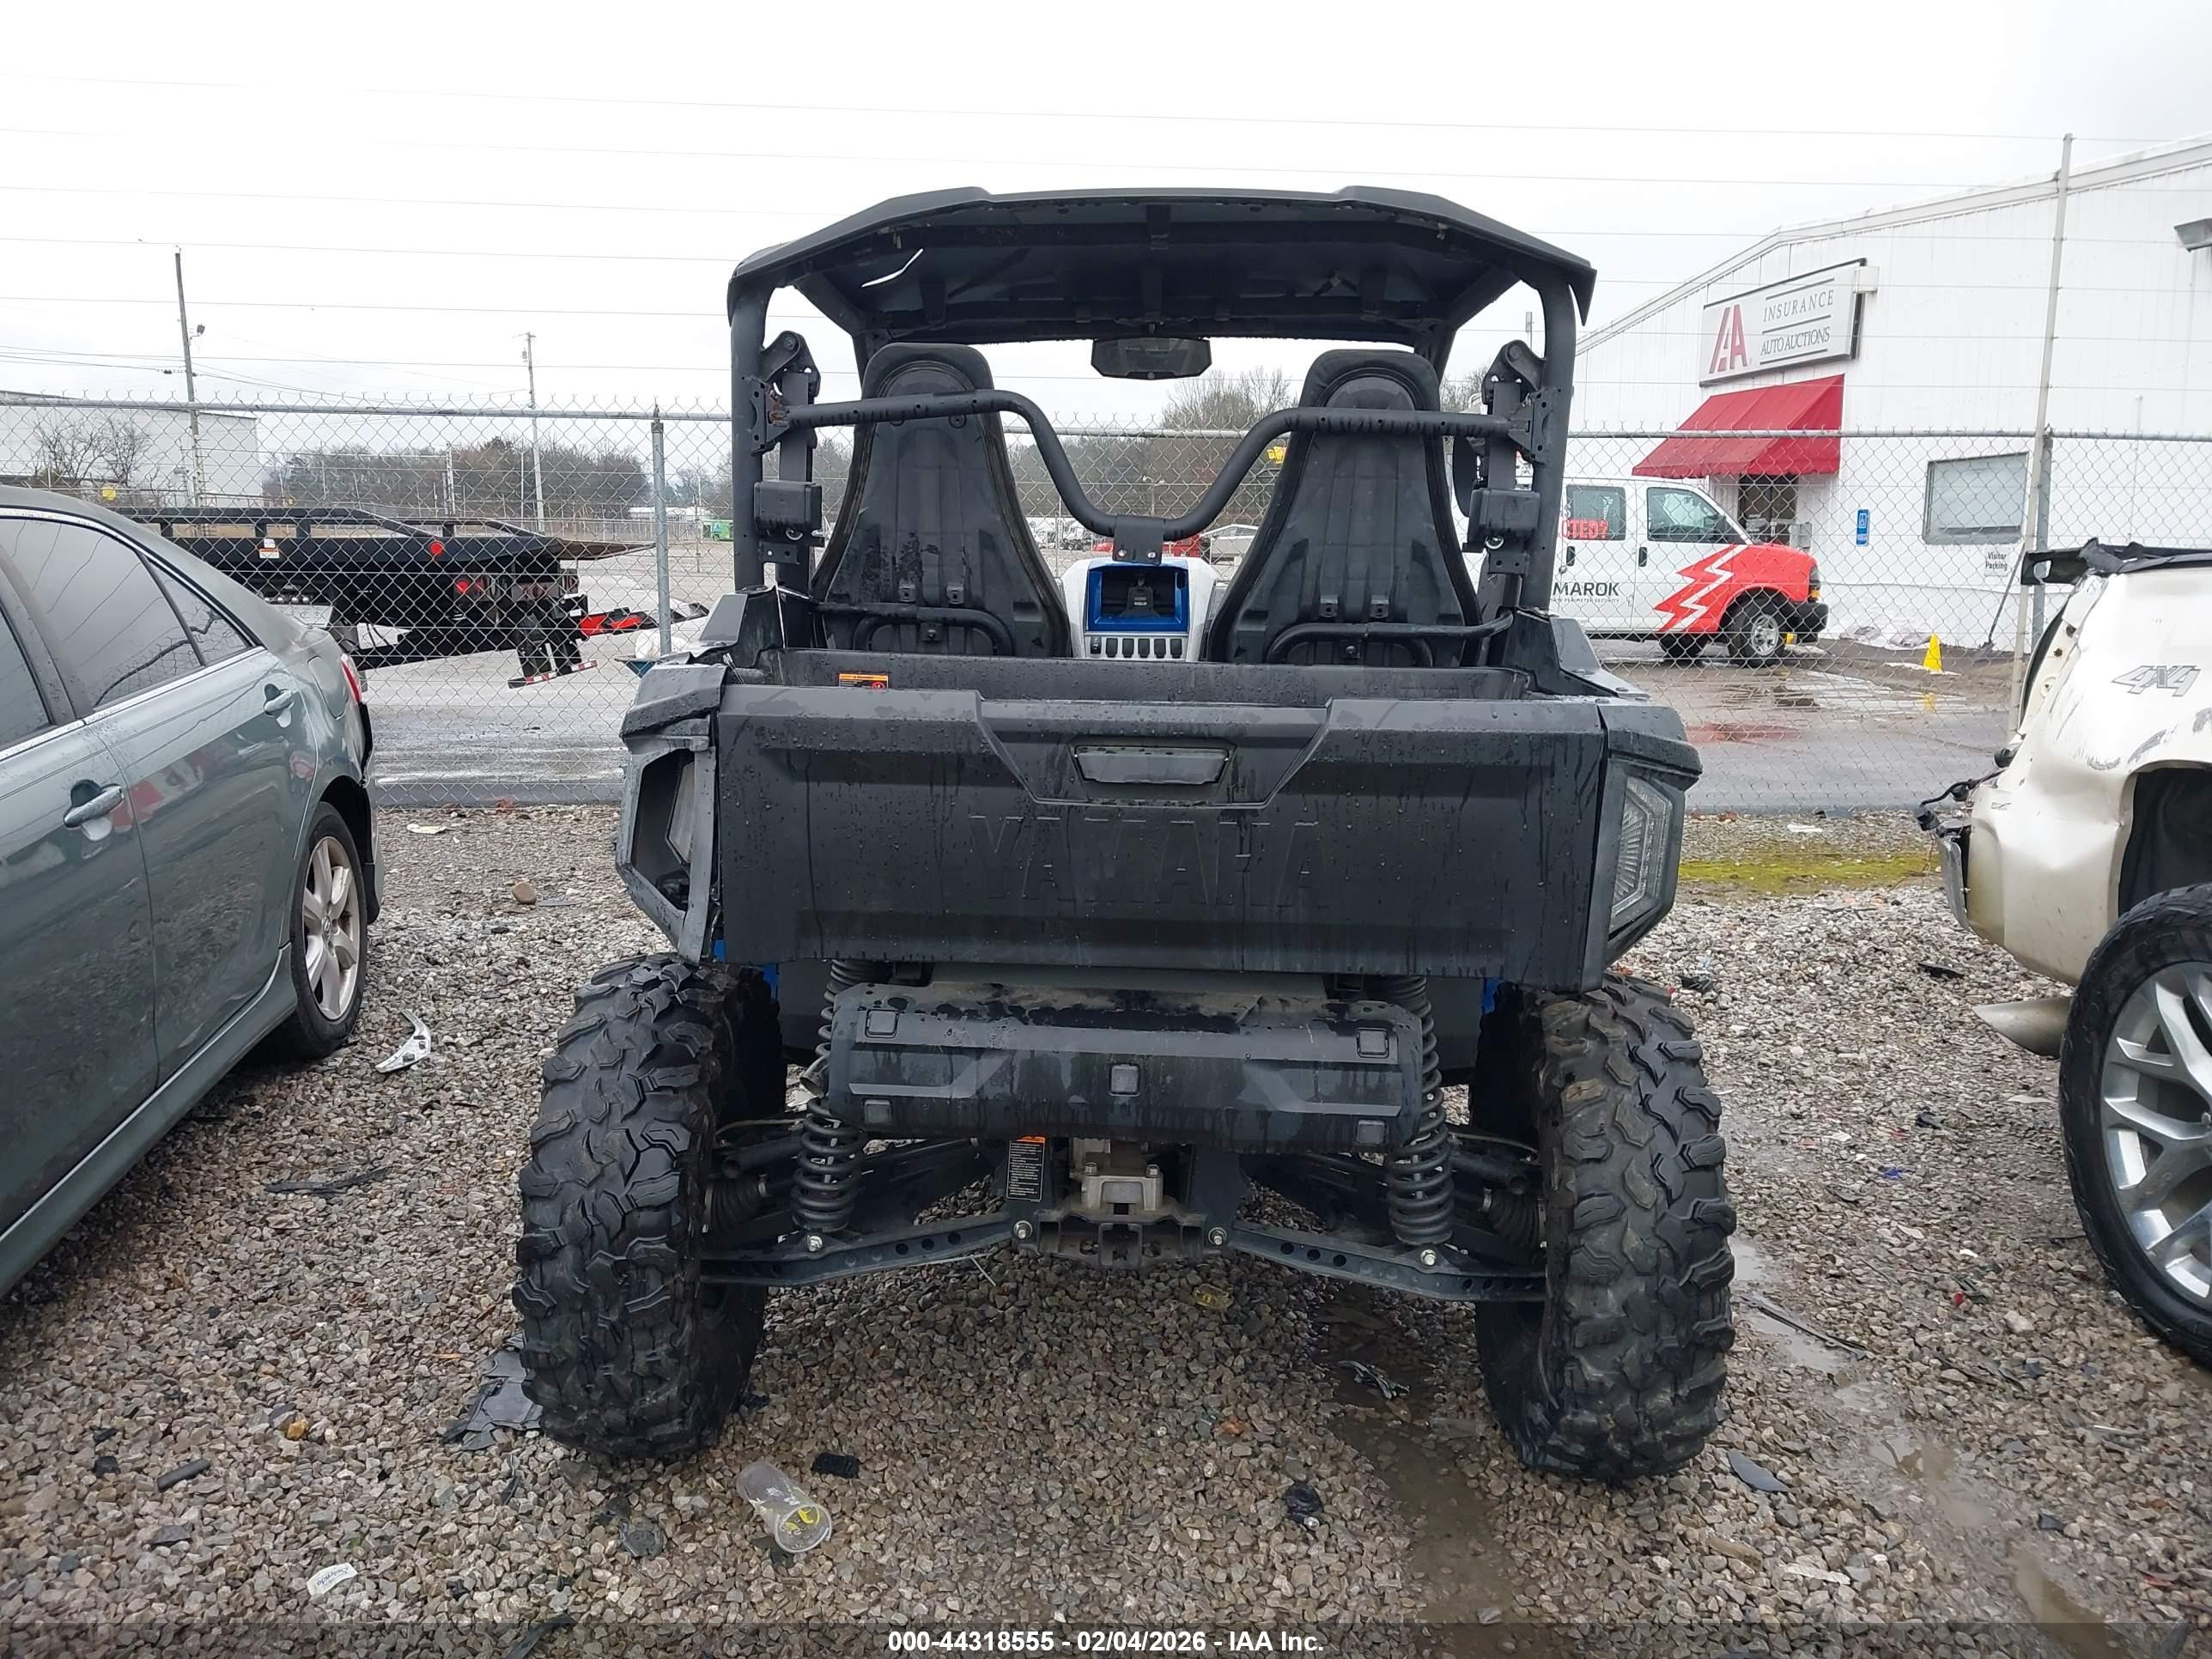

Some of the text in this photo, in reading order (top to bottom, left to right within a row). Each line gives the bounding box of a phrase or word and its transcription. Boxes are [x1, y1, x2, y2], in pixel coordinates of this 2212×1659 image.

[1763, 289, 1834, 323] INSURANCE
[1760, 325, 1831, 356] AUTO AUCTIONS
[1561, 518, 1608, 540] CTED?
[1988, 550, 2007, 560] Visitor
[1985, 561, 2008, 572] Parking
[1553, 581, 1620, 597] MAROK
[969, 815, 1331, 908] YAMAHA
